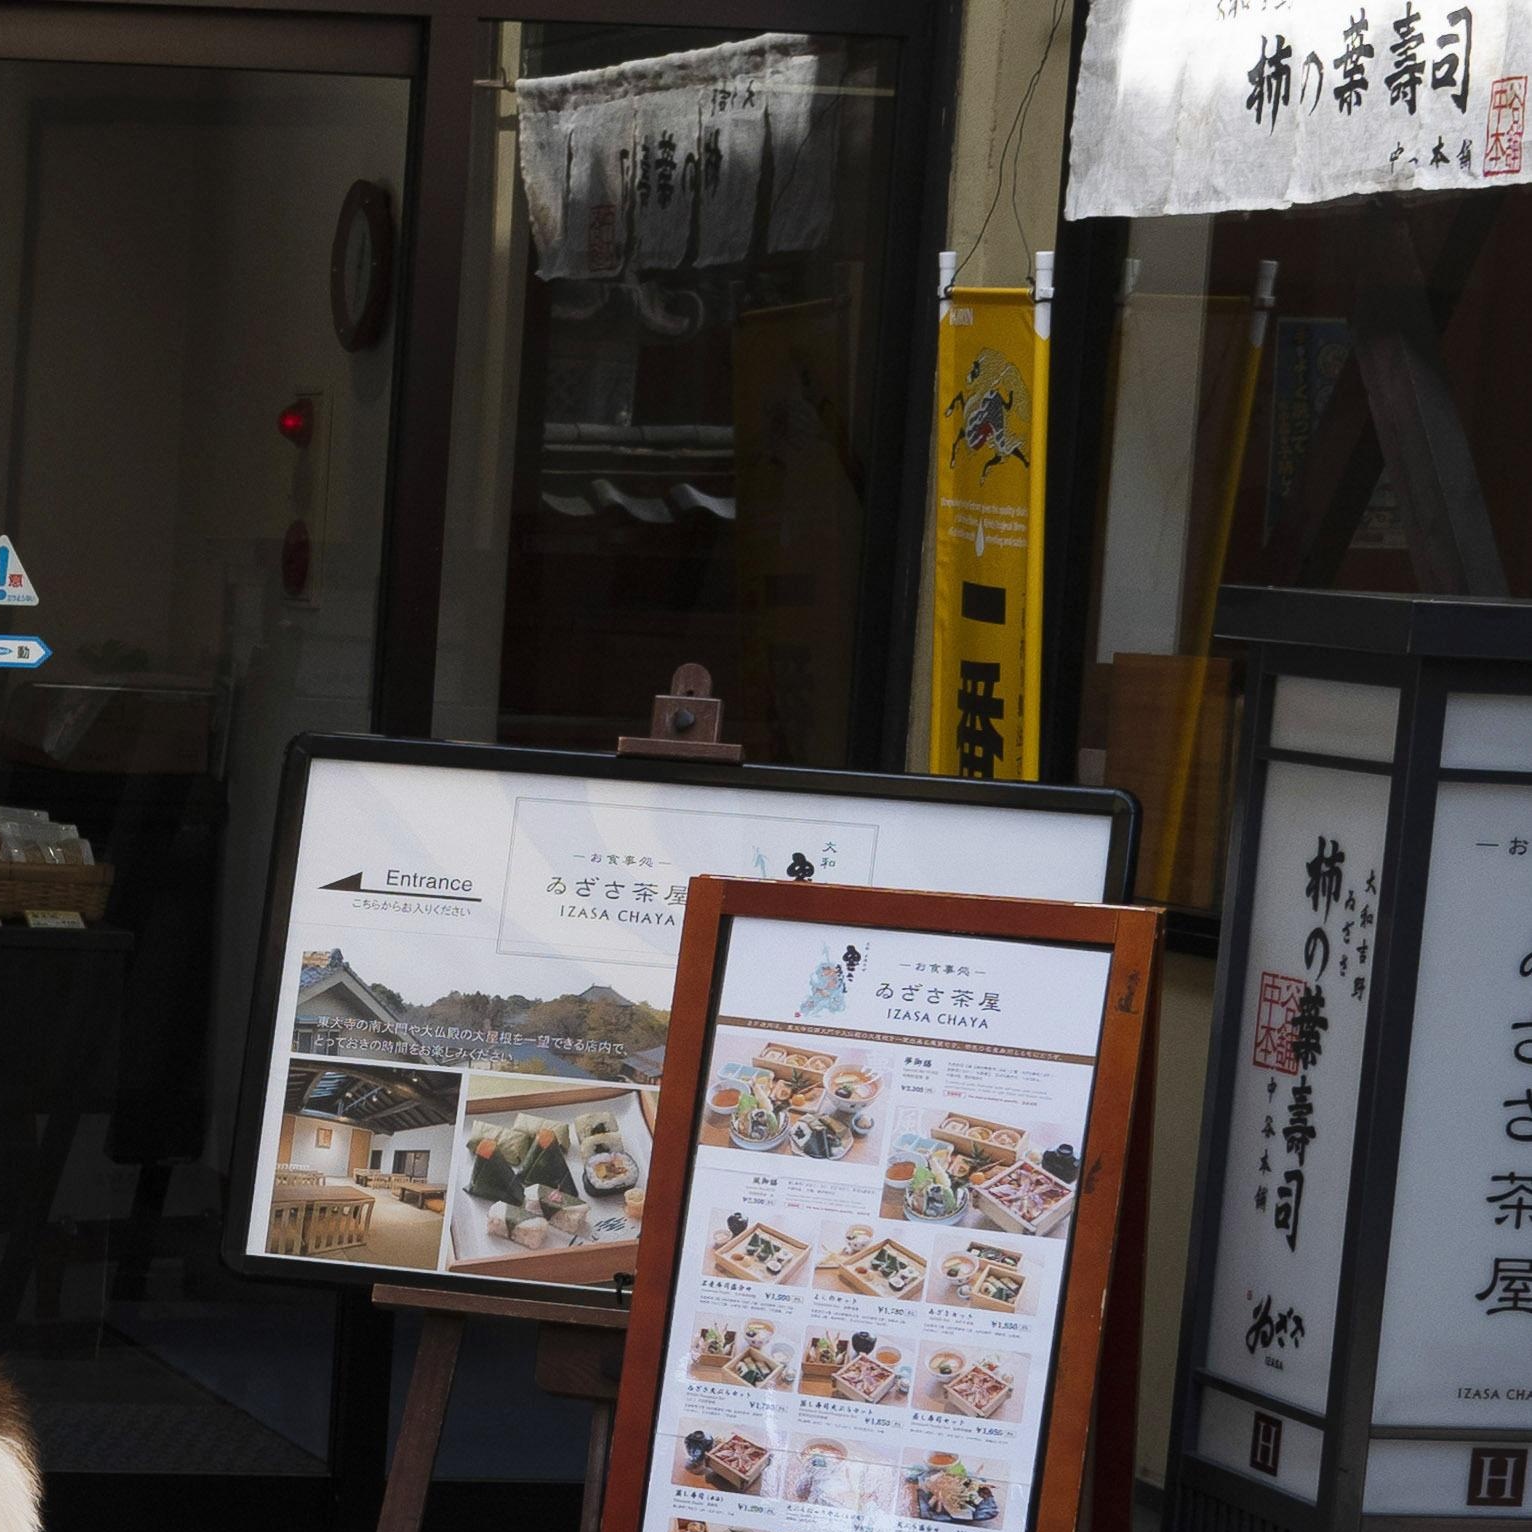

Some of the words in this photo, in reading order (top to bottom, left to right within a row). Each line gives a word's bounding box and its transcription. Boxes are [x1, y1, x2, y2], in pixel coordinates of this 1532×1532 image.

[386, 870, 473, 892] Entrance
[546, 876, 688, 906] ゐざさ茶屋
[352, 898, 471, 917] こちらからお入りください
[560, 905, 610, 921] IZASA
[618, 910, 676, 926] CHAYA
[876, 982, 1001, 1012] ゐざさ茶屋
[887, 1008, 931, 1023] IZASA
[937, 1013, 988, 1029] CHAYA
[1457, 1387, 1500, 1400] IZASA
